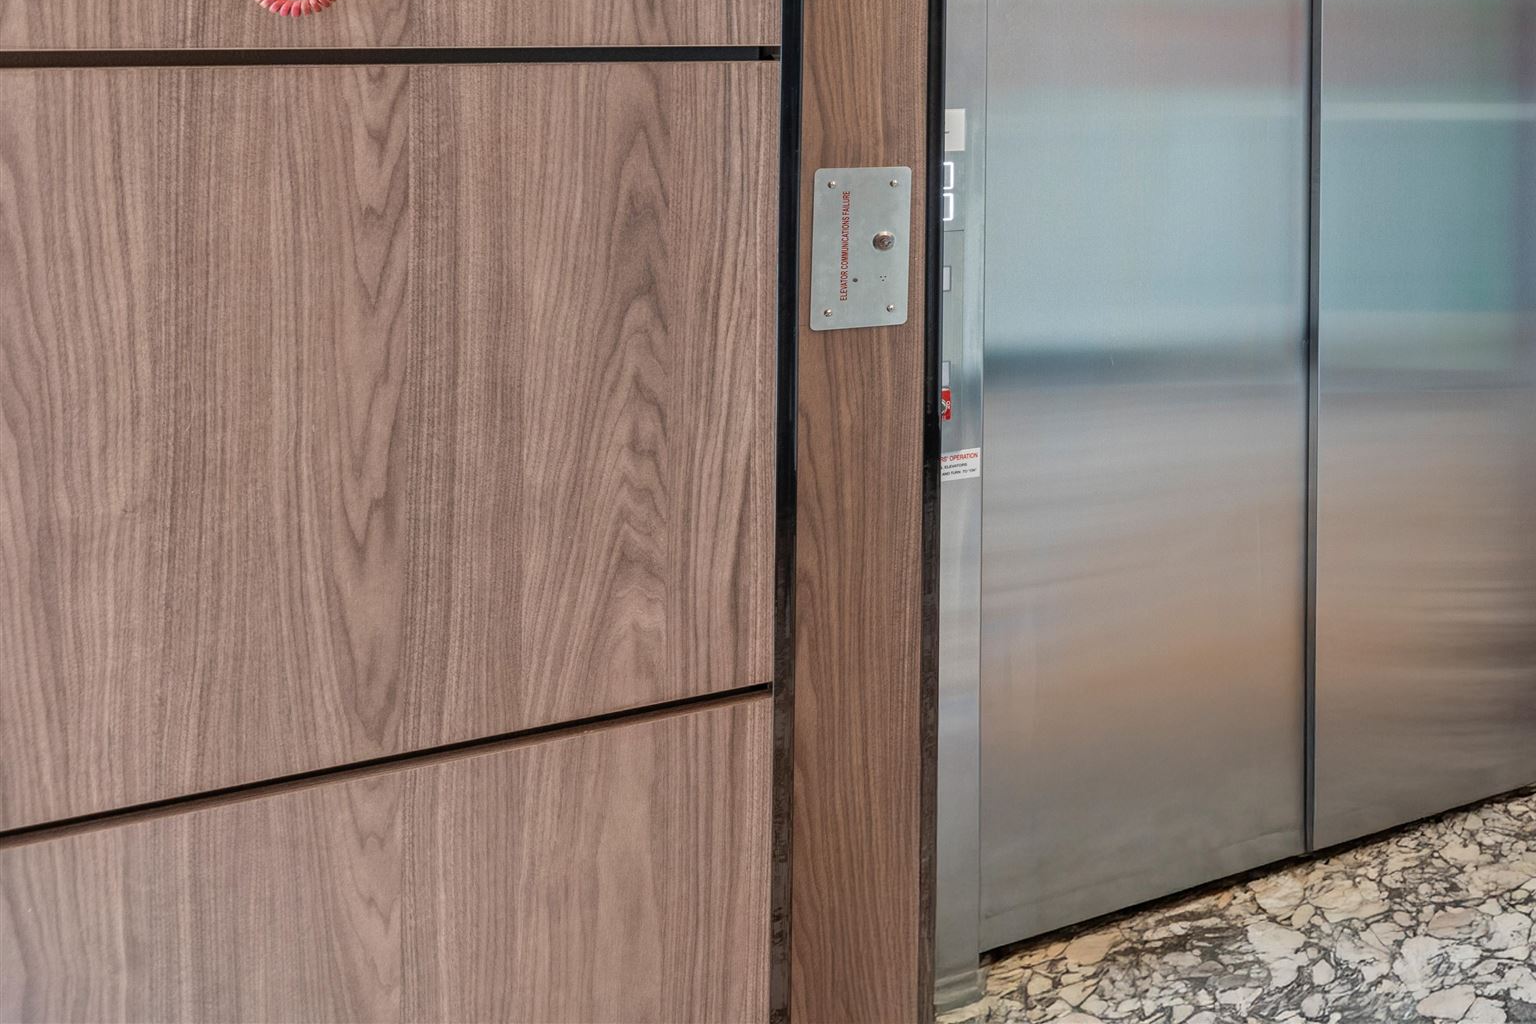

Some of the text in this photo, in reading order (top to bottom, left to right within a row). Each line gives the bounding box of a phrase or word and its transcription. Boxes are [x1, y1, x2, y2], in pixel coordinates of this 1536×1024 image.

[840, 191, 850, 301] ELEVATOR COMMUNICATIONS FAILURE
[950, 453, 978, 461] OPERATION
